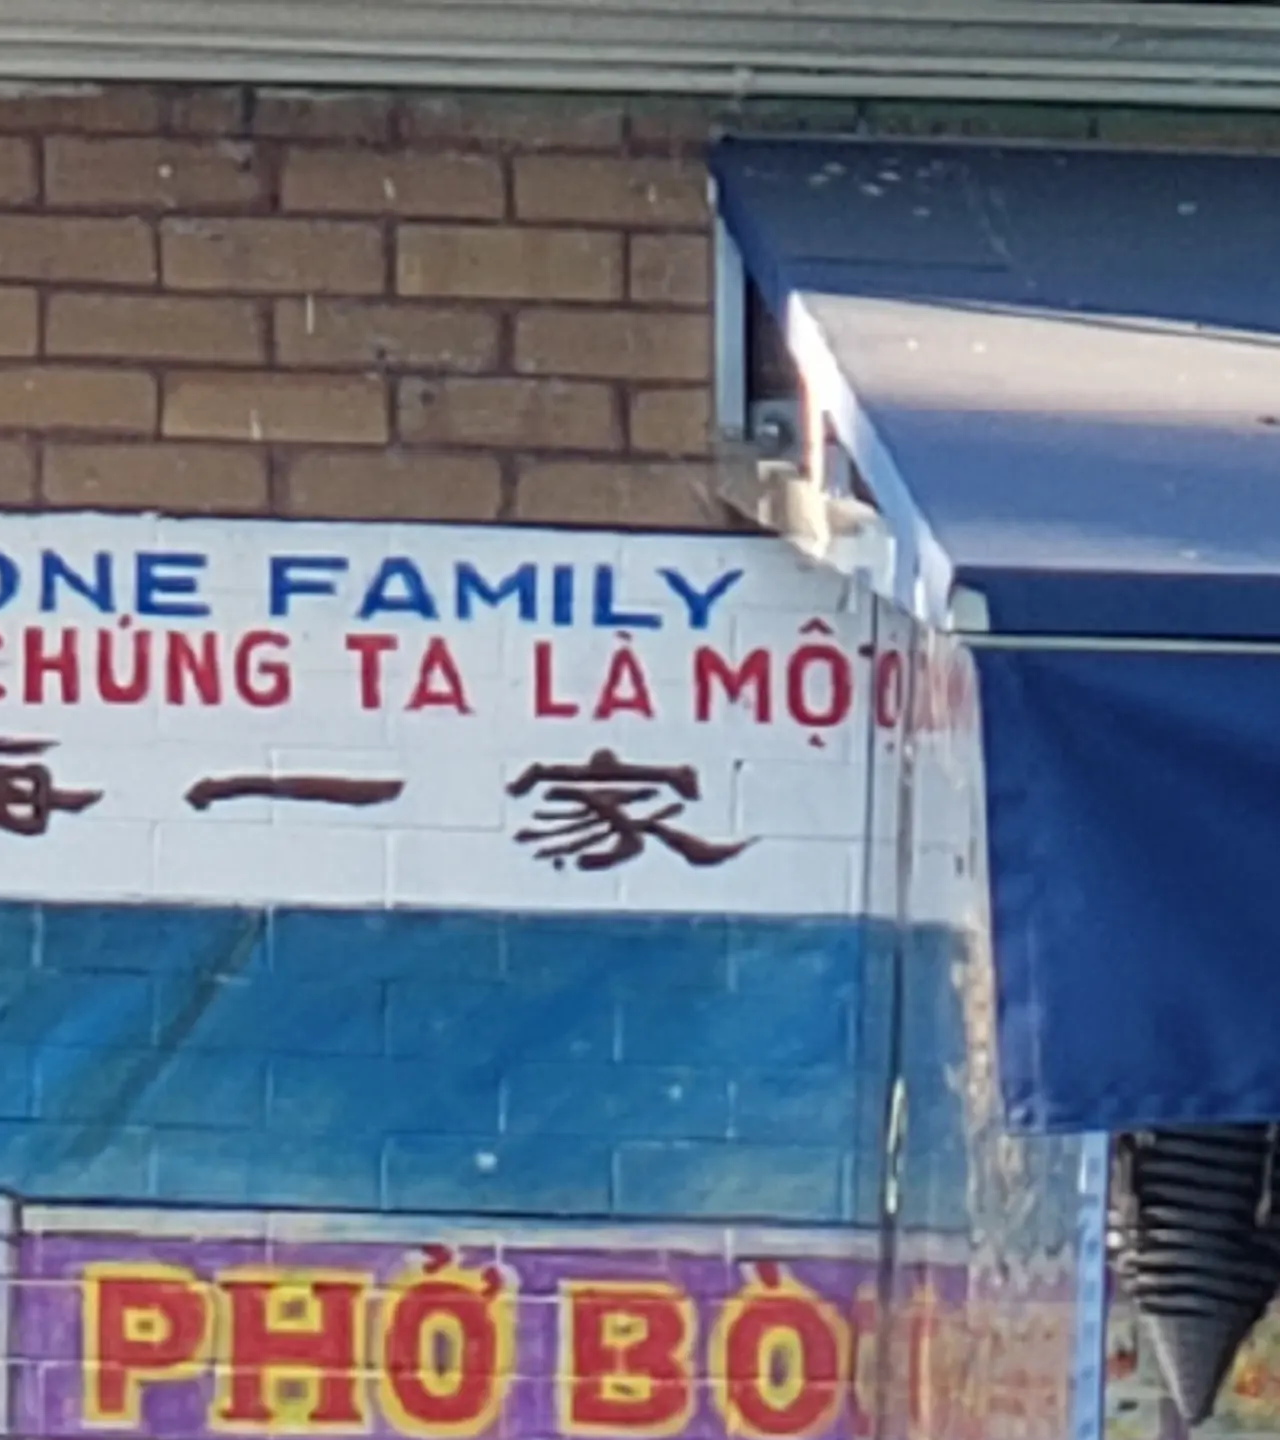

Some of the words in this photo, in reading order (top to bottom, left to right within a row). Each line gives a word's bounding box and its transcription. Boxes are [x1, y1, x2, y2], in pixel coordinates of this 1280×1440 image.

[267, 554, 744, 630] FAMILY
[344, 632, 476, 716] TA
[531, 629, 655, 722] LÀ
[80, 1241, 520, 1440] PHỞ
[557, 1262, 852, 1440] BÒ
